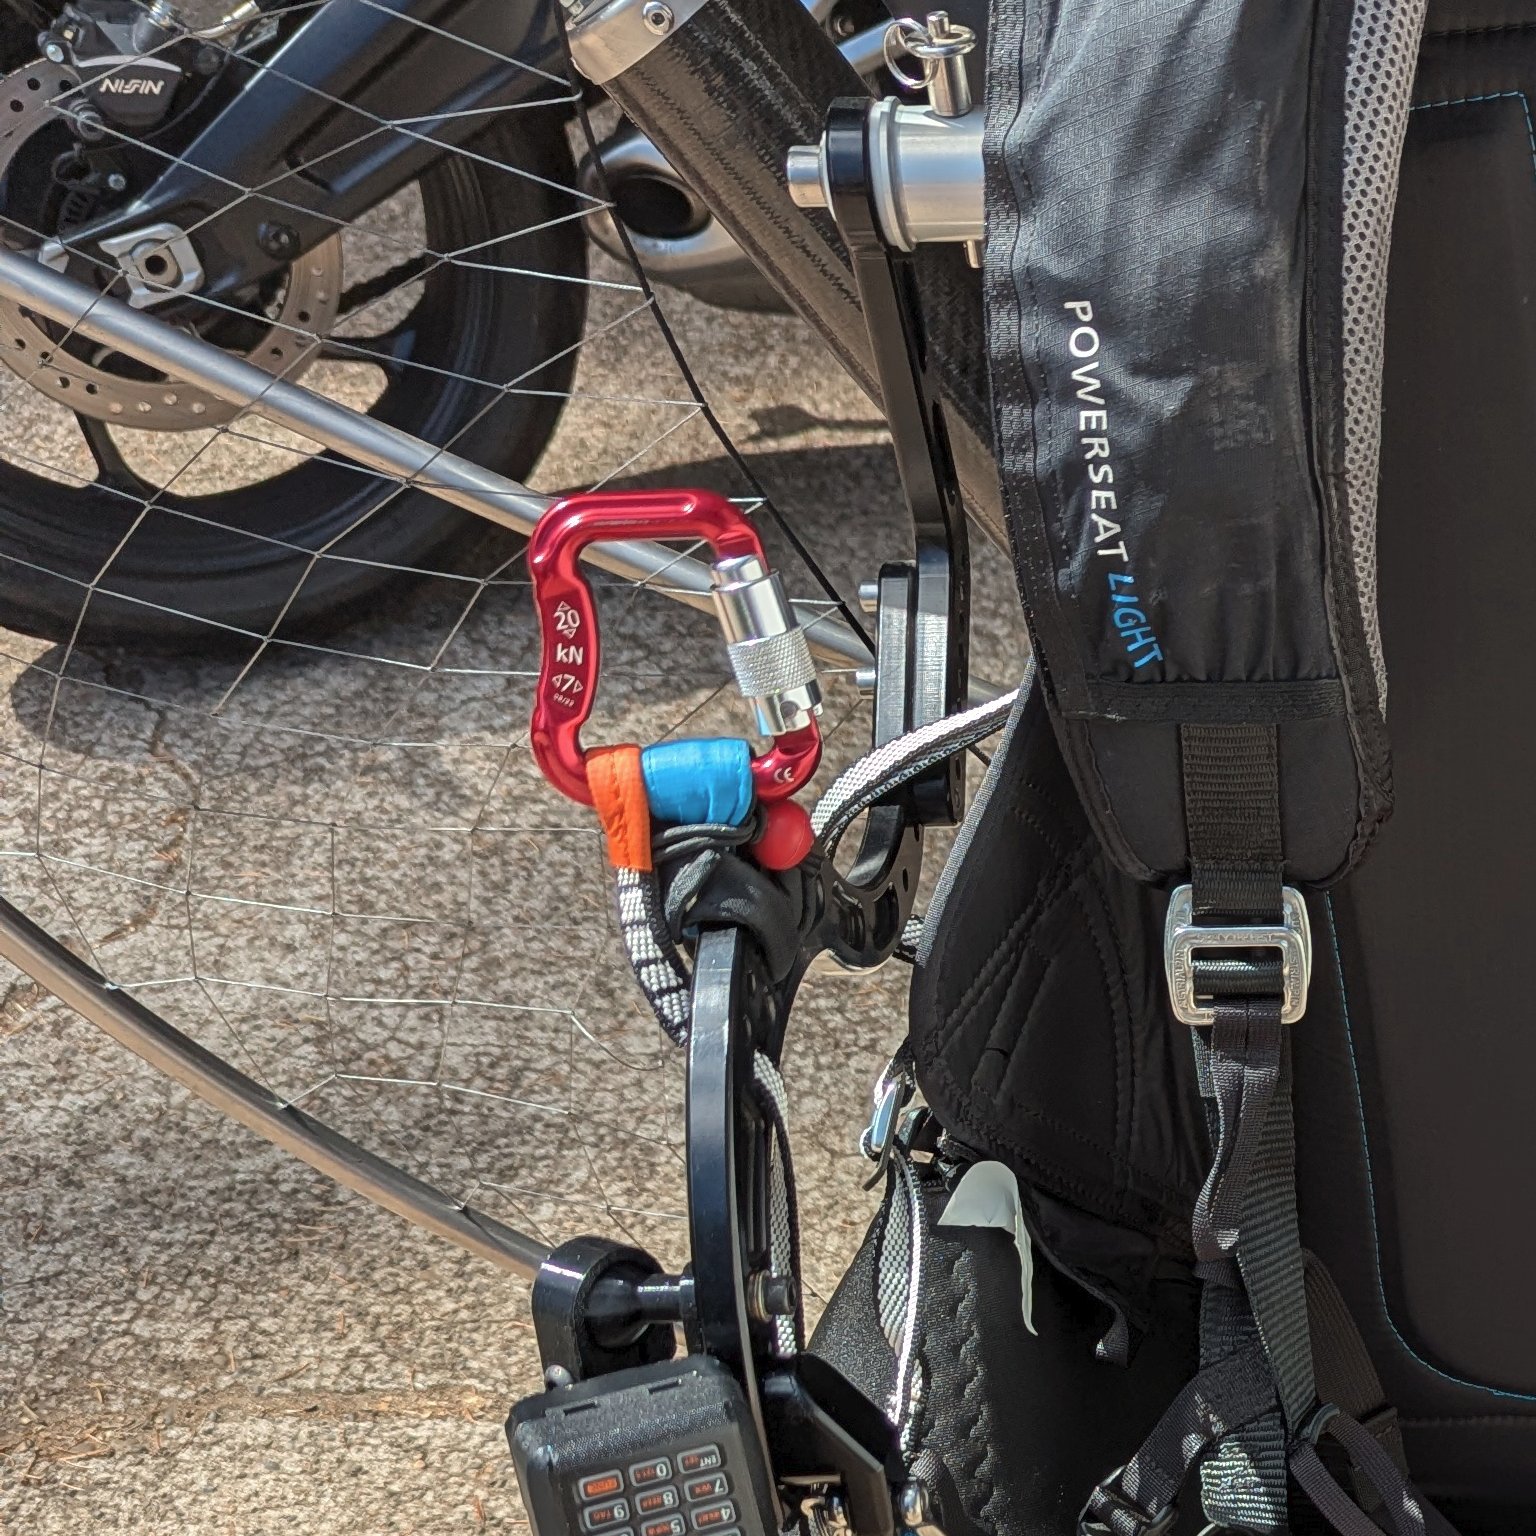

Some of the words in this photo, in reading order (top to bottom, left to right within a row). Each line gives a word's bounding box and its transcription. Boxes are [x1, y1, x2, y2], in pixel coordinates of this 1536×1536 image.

[1062, 299, 1129, 563] POWERSEAT
[1106, 570, 1166, 669] LIGHT
[553, 608, 581, 632] 20
[555, 642, 584, 666] kN
[561, 673, 576, 693] 7
[655, 1463, 667, 1477] 0
[714, 1479, 723, 1493] 7
[662, 1491, 674, 1506] 8
[613, 1505, 625, 1519] 9
[720, 1508, 731, 1521] 4
[669, 1520, 681, 1534] 5
